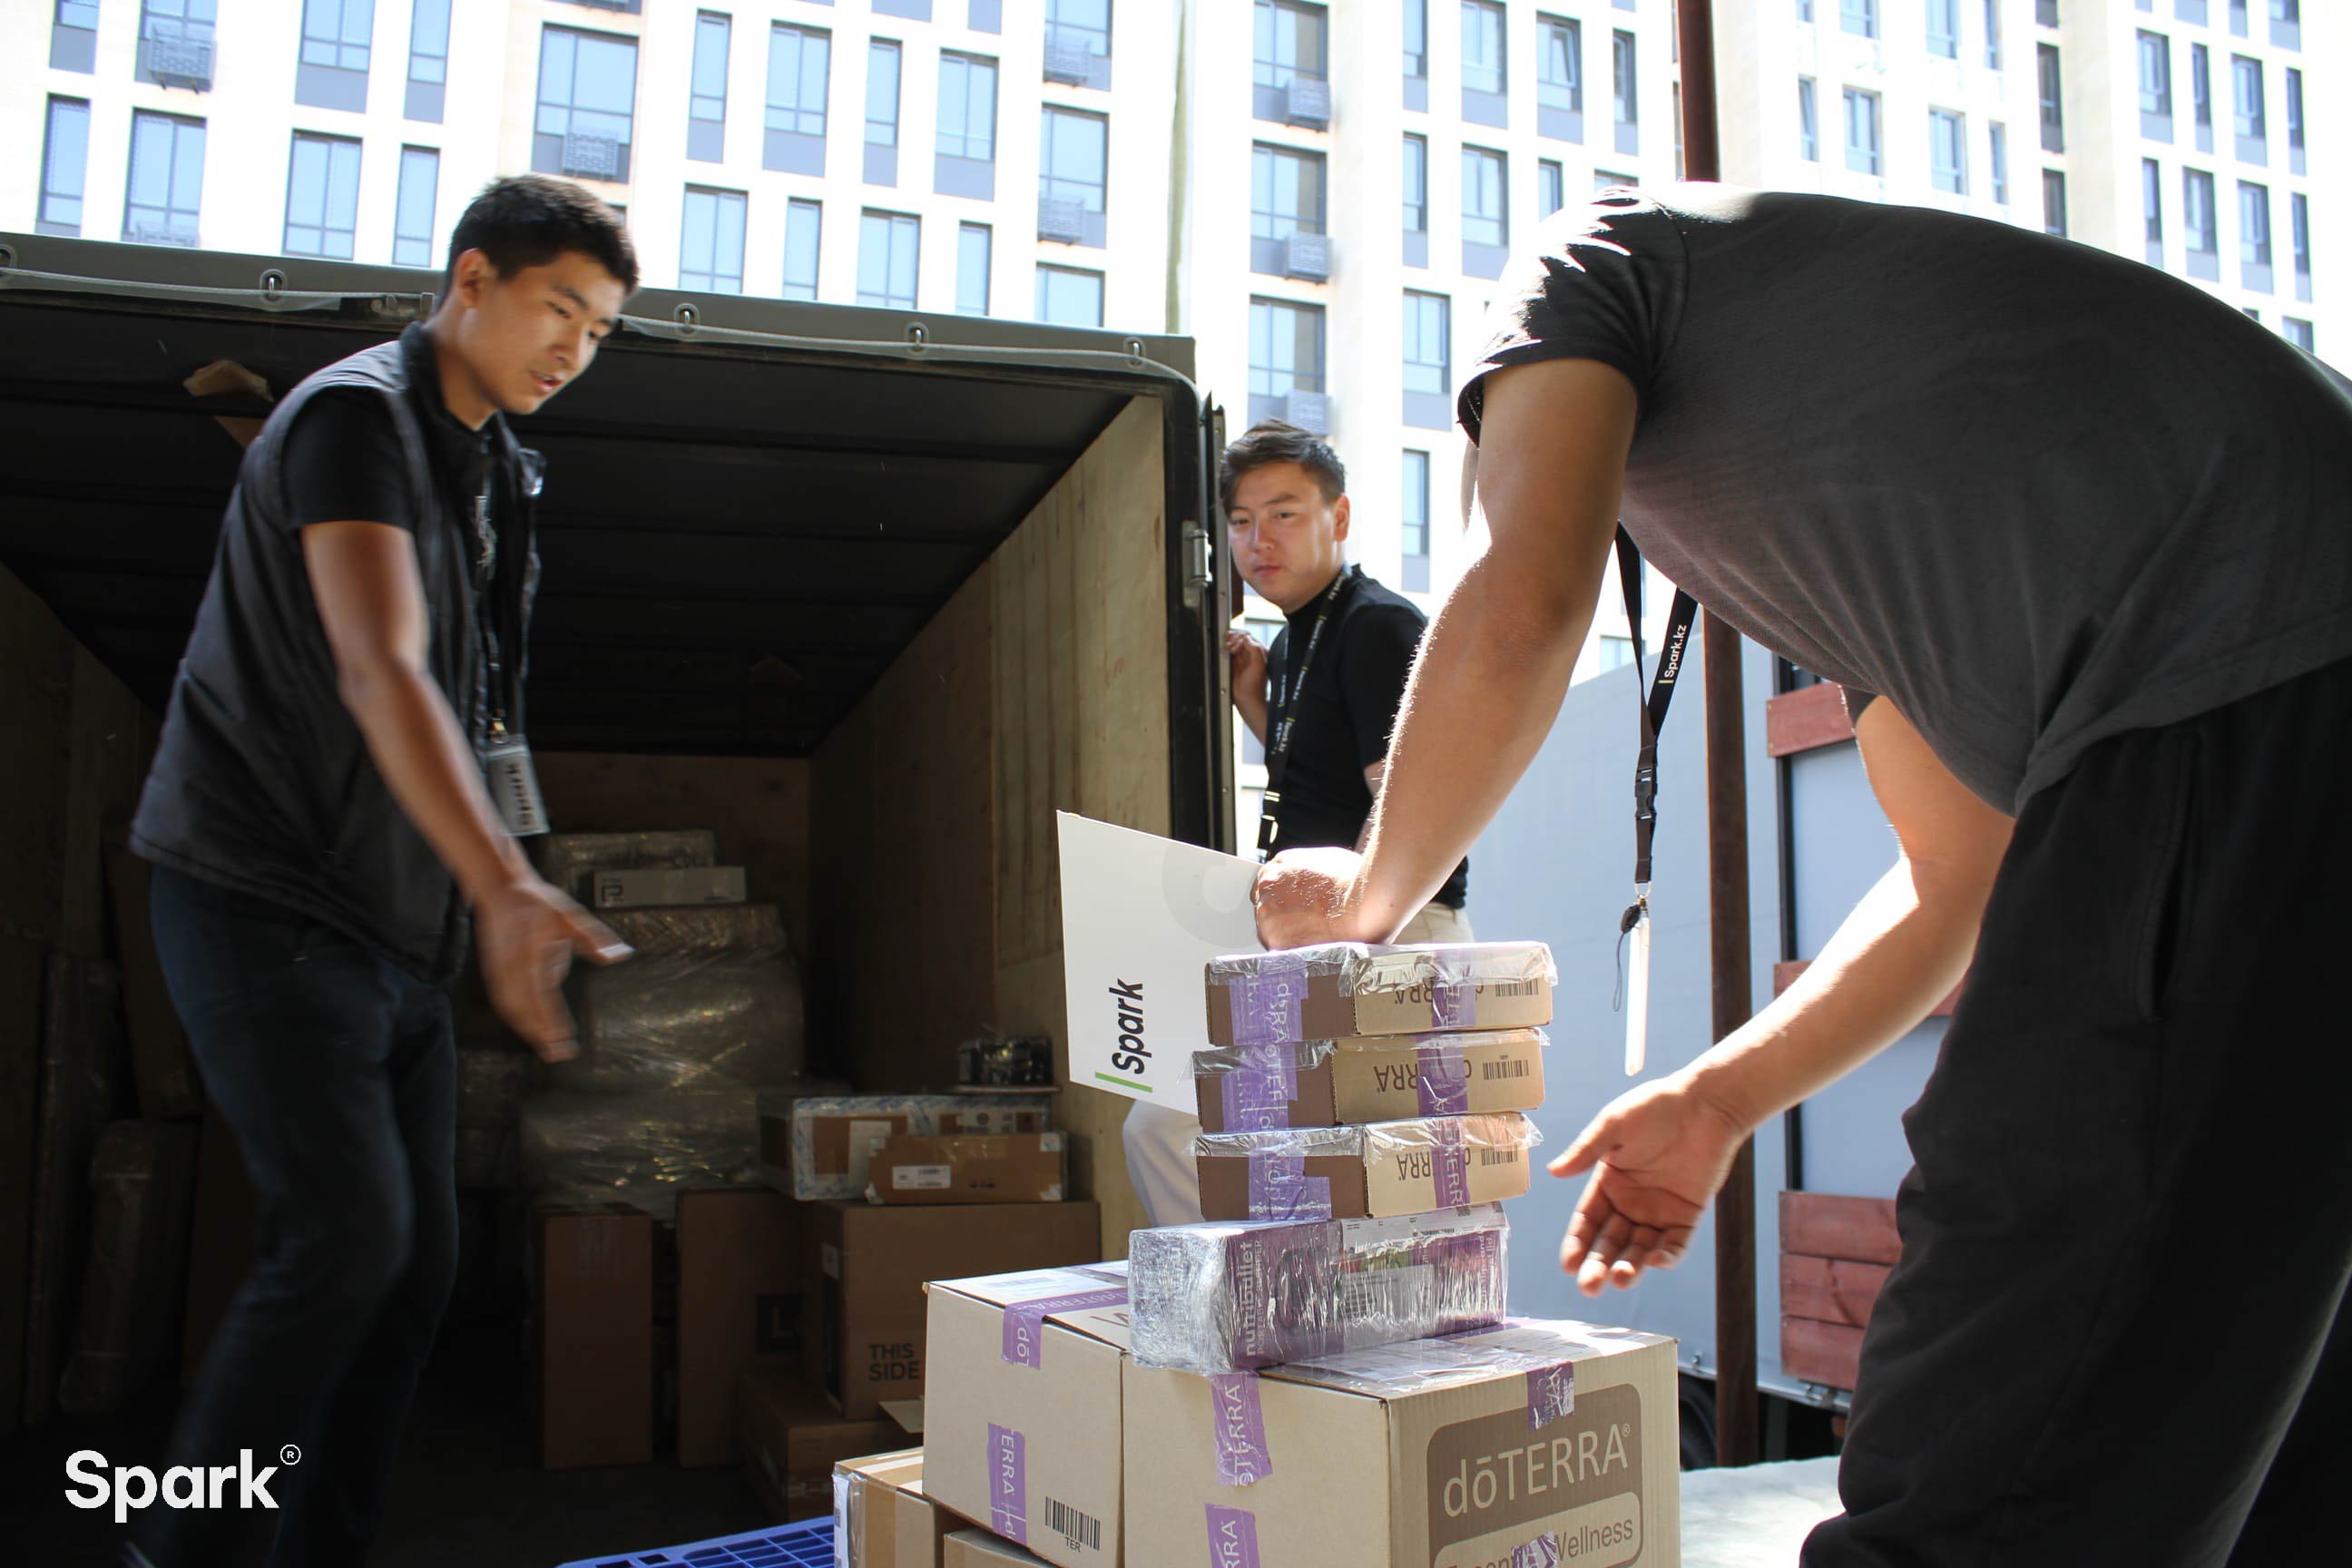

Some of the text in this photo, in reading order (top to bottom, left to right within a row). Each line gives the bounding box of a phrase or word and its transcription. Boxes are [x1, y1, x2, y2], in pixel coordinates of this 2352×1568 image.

[1663, 623, 1688, 679] Spark.kz
[1108, 977, 1152, 1075] Spark
[1235, 1240, 1257, 1357] nutribullet
[868, 1342, 915, 1361] THIS
[868, 1359, 922, 1382] SIDE
[1001, 1429, 1015, 1495] ERRA
[1064, 1536, 1082, 1553] TER
